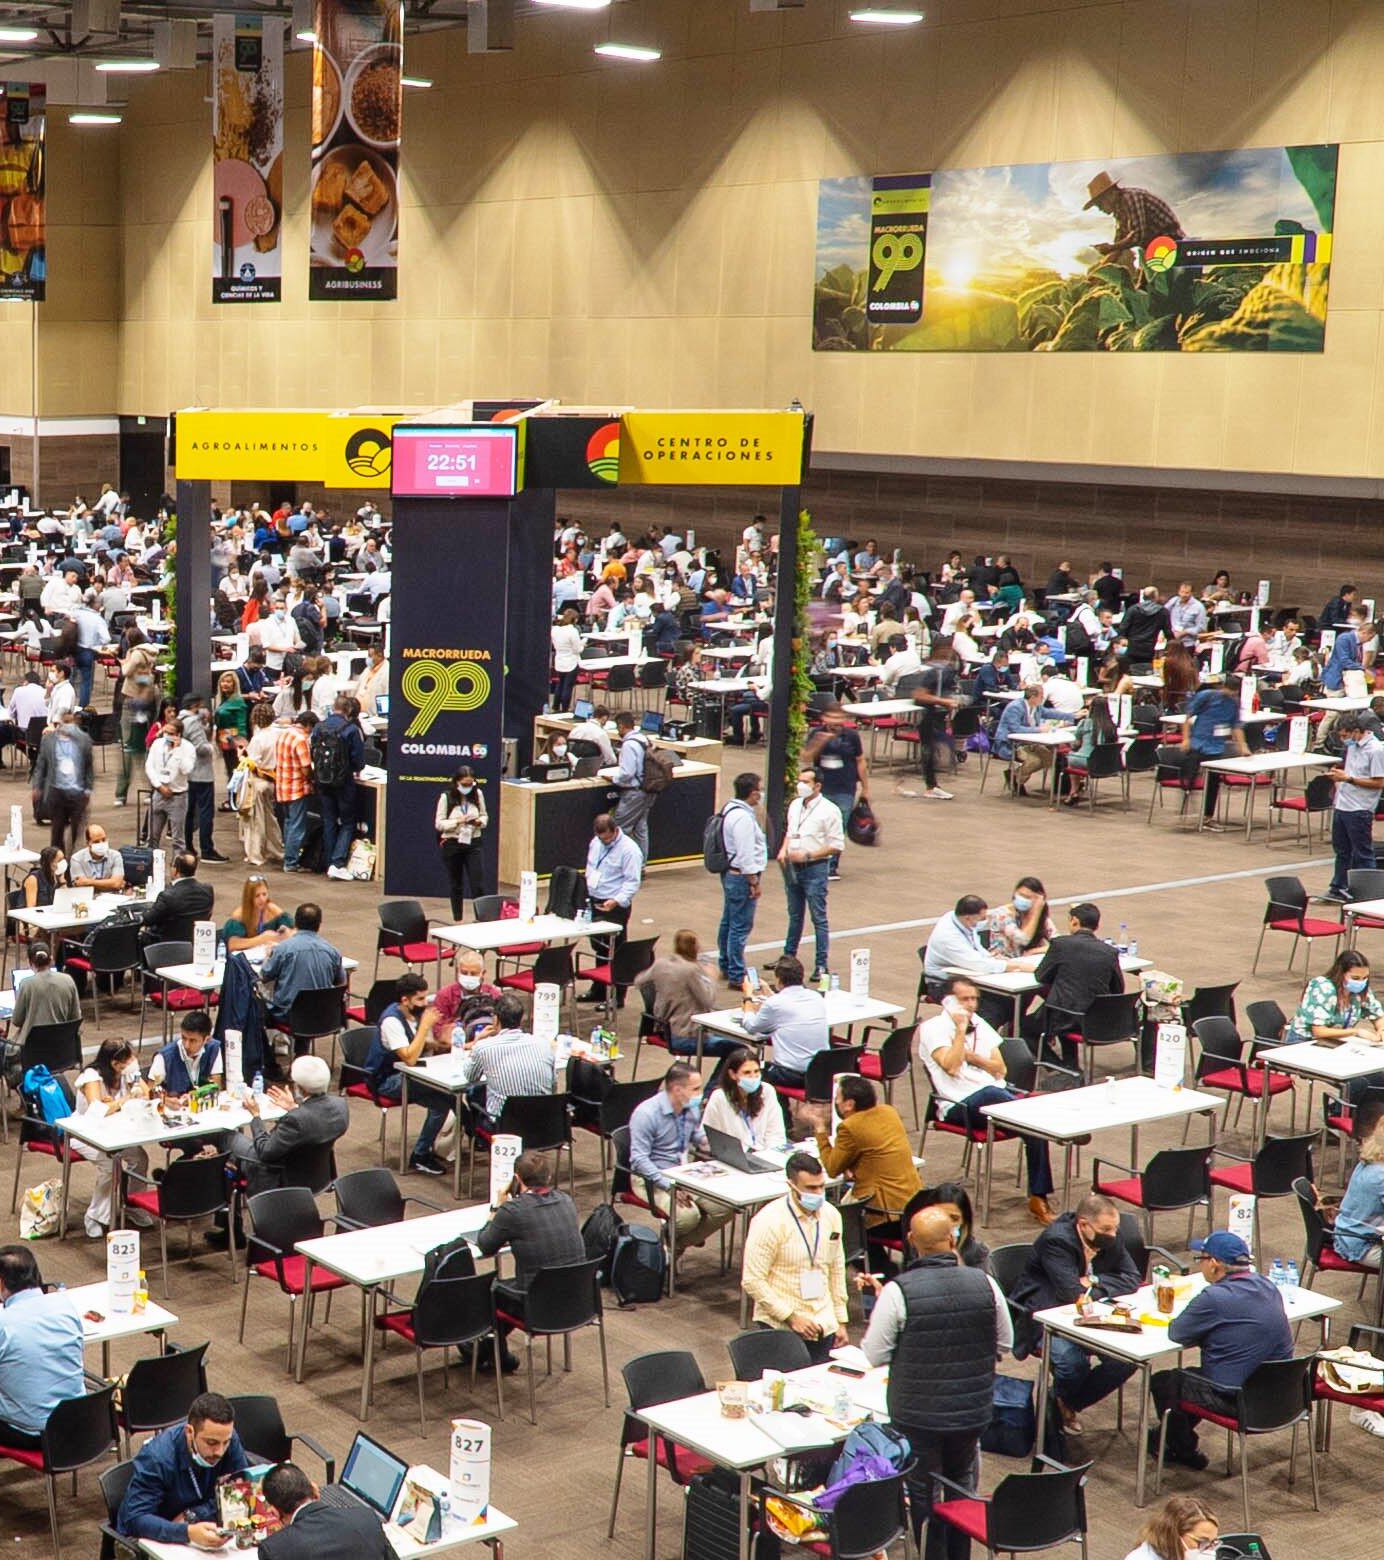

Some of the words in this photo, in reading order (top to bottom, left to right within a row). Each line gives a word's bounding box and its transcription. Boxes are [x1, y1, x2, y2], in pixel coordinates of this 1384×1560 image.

[873, 233, 924, 293] 90
[325, 280, 383, 289] AGRIBUSINESS
[869, 301, 909, 311] COLOMBIA
[191, 442, 319, 452] AGROALIMENTOS
[657, 438, 728, 447] CENTRO
[740, 438, 760, 447] DE
[643, 451, 773, 461] OPERACIONES
[427, 455, 476, 470] 22:51
[402, 648, 491, 661] MACRORRUEDA
[401, 660, 491, 737] 90
[401, 743, 471, 757] COLOMBIA
[537, 991, 557, 1001] 799
[494, 1145, 517, 1157] 822
[112, 1243, 136, 1255] 823
[454, 1435, 484, 1453] 827
